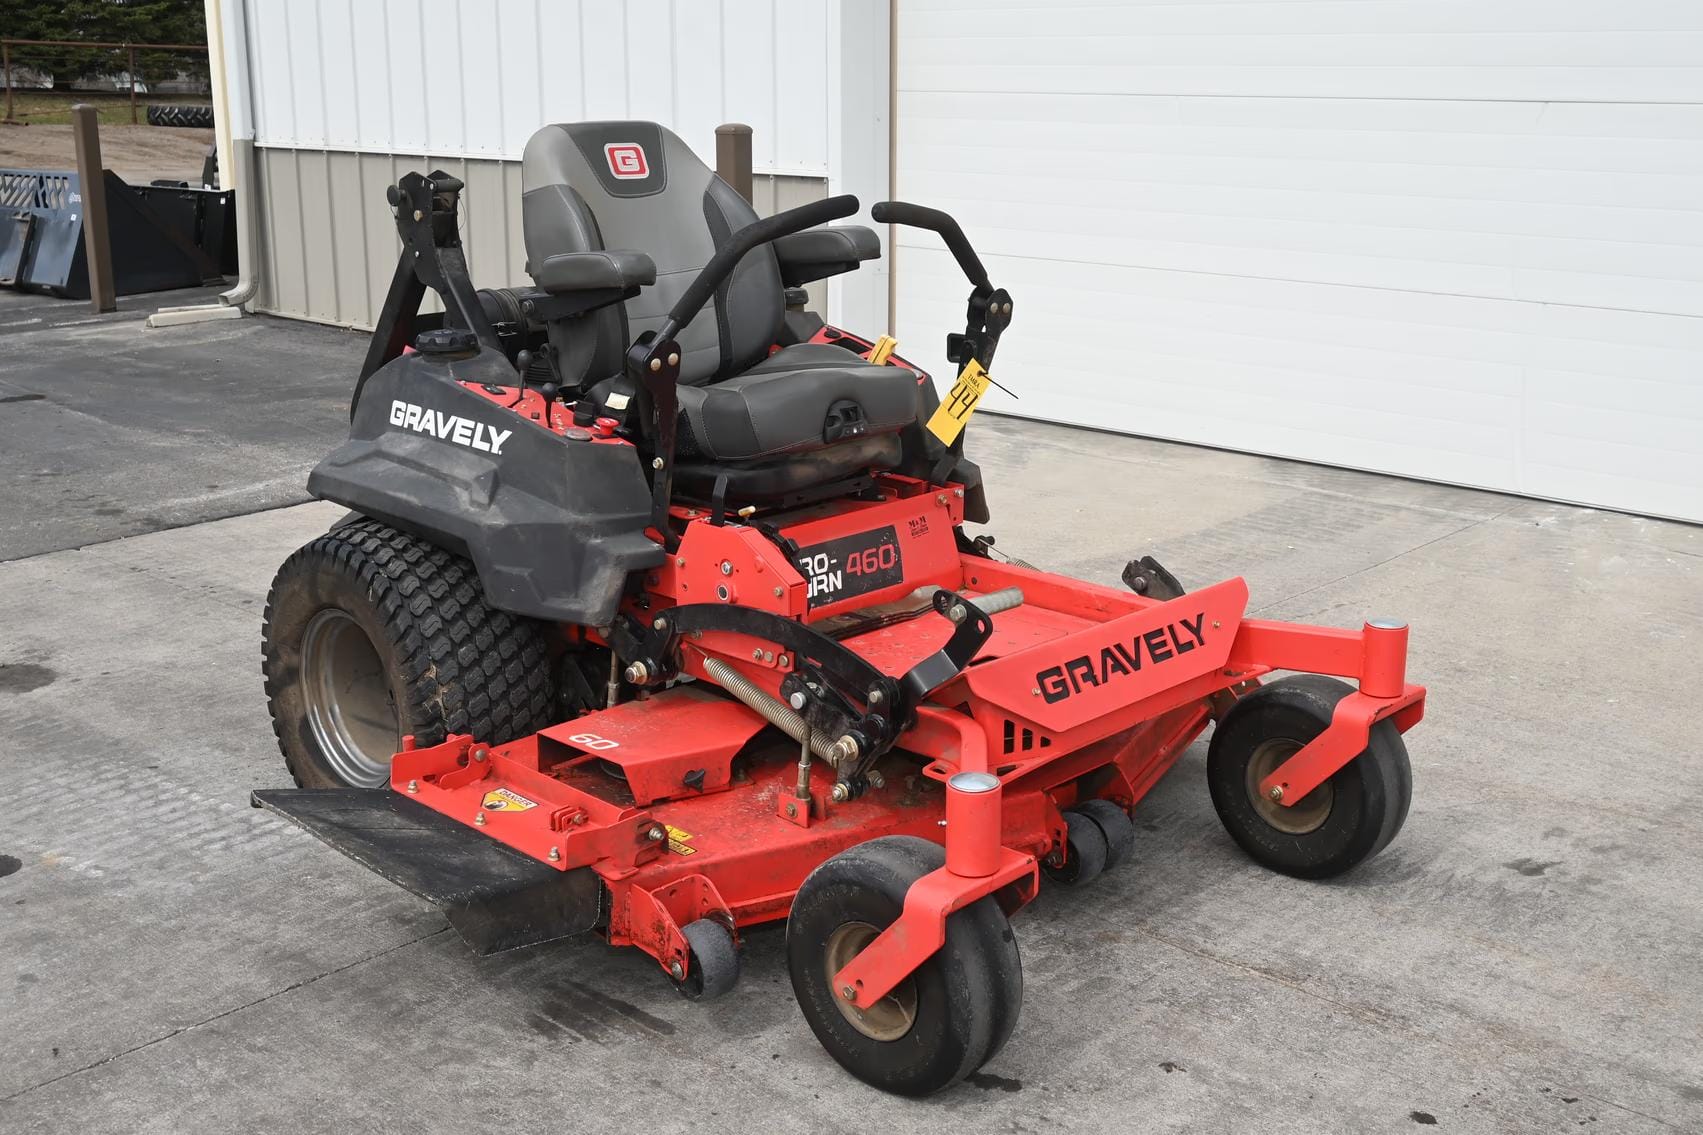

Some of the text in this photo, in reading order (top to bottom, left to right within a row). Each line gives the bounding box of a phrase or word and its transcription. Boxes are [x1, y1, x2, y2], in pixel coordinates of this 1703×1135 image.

[947, 382, 979, 420] 44
[389, 399, 513, 454] GRAVELY
[799, 552, 838, 577] RO-
[846, 543, 897, 577] 460
[1036, 612, 1205, 704] GRAVELY
[568, 733, 620, 750] 60
[498, 789, 533, 807] DANGER
